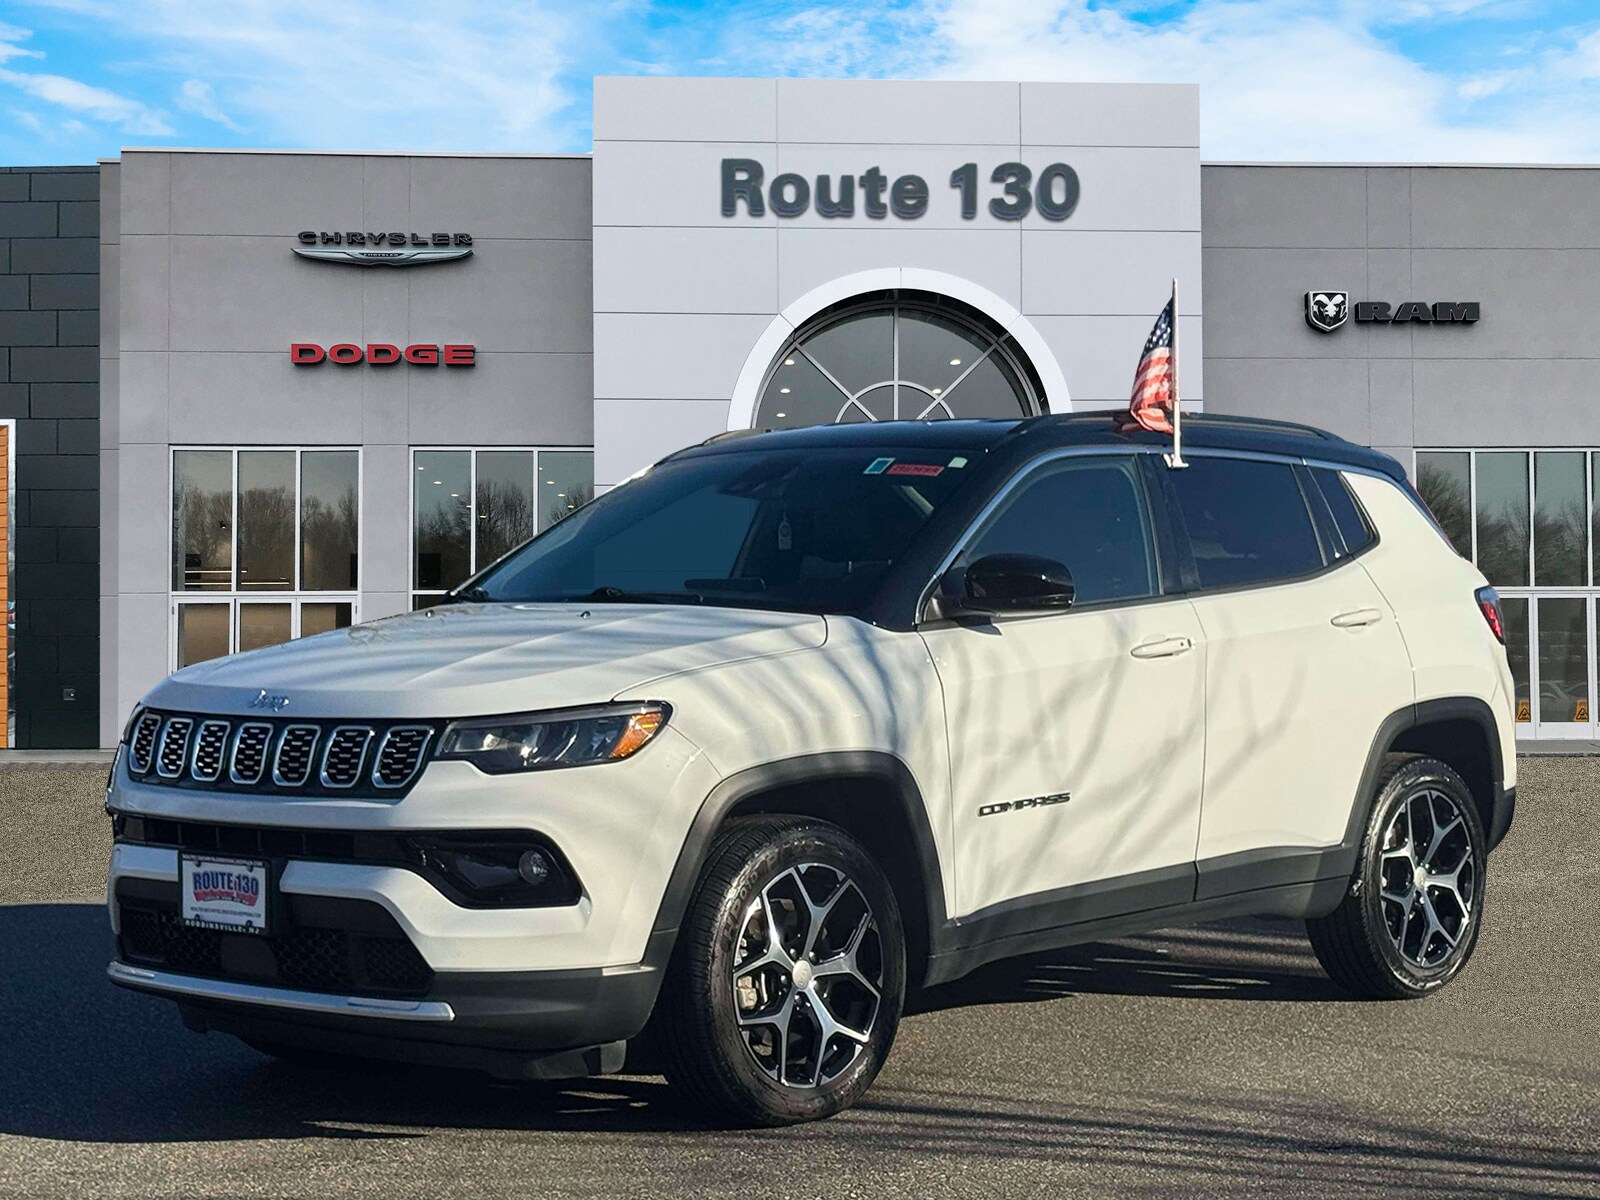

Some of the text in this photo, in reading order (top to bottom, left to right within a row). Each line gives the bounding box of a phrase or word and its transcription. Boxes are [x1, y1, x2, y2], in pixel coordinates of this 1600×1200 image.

[721, 158, 1080, 221] Route 130
[298, 231, 472, 245] CHRYSLER
[1355, 302, 1480, 323] RAM
[291, 343, 476, 367] DODGE
[978, 792, 1071, 817] COMPASS
[192, 871, 259, 896] ROUTE 130
